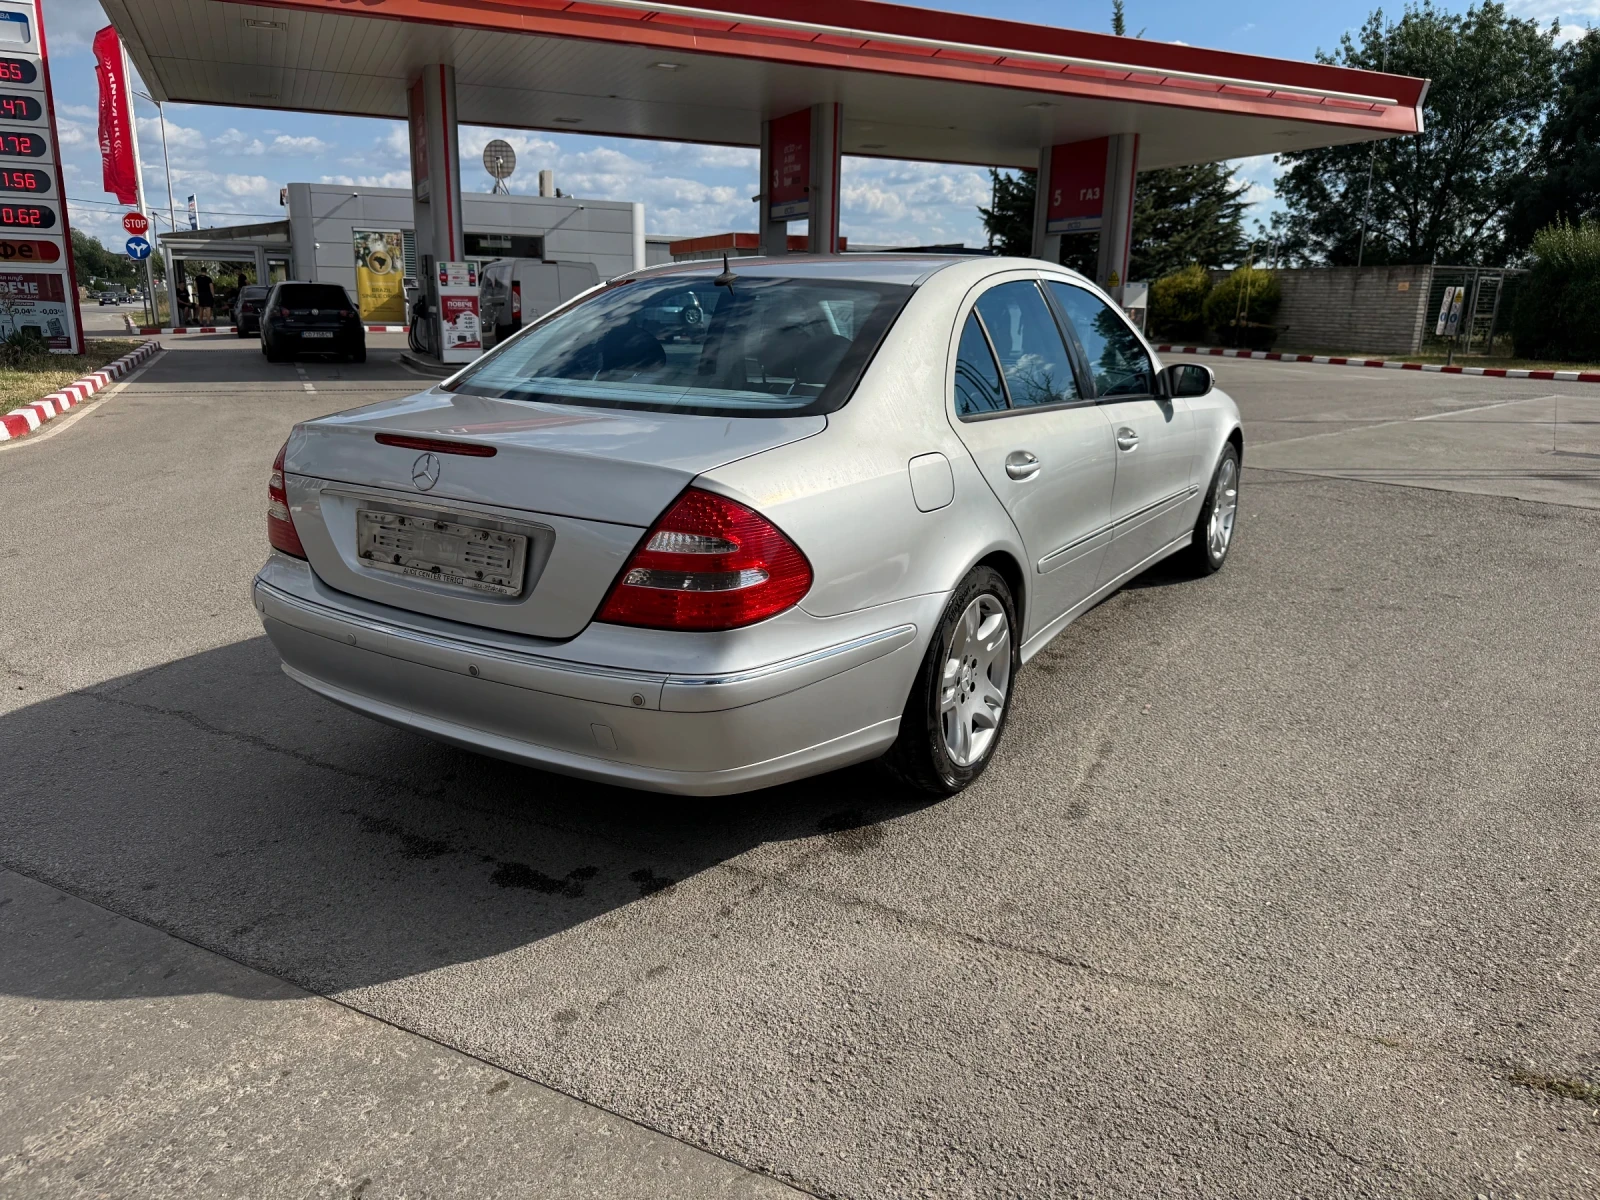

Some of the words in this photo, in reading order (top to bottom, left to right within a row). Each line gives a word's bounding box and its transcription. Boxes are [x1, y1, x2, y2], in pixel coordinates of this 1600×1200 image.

[2, 172, 37, 190] 1.56
[773, 169, 779, 188] 3
[1053, 189, 1062, 206] 5
[1079, 187, 1100, 201] ГАЗ
[2, 208, 41, 225] 0.62
[124, 218, 147, 229] STOP
[418, 570, 442, 581] CENTER
